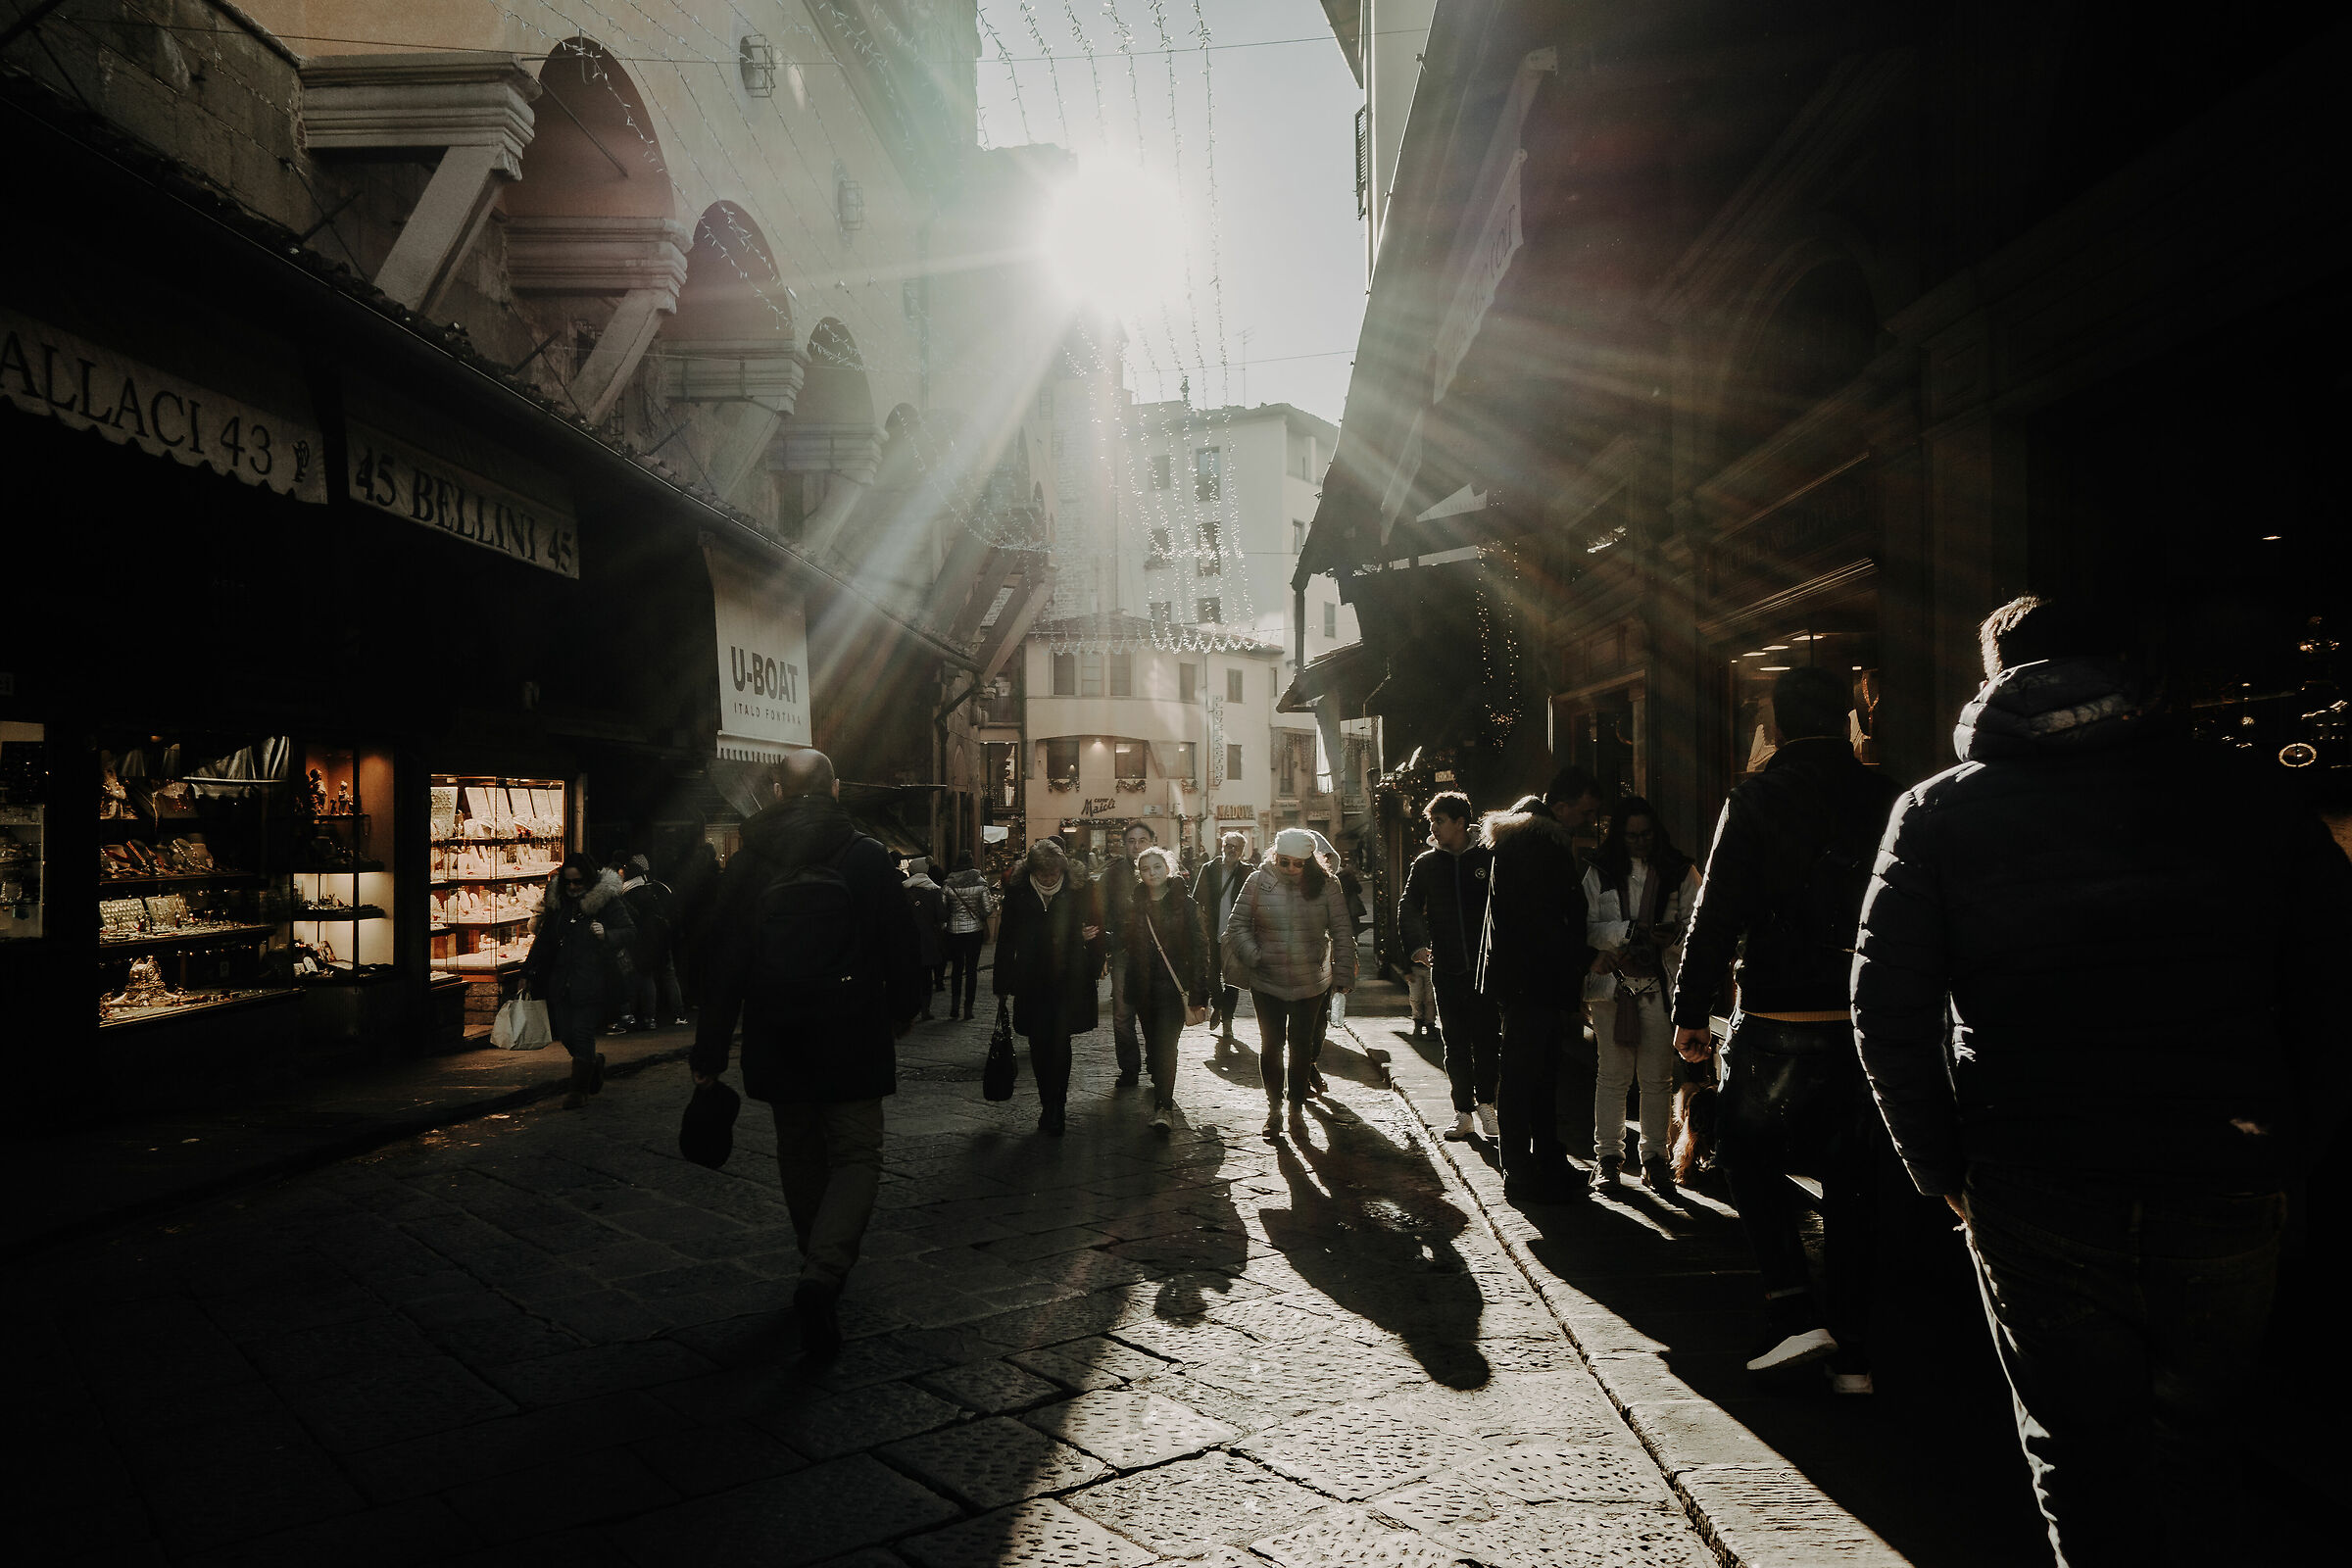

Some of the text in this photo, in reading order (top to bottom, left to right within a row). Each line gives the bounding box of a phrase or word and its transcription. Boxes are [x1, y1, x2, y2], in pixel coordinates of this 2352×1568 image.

[0, 331, 272, 475] ALLACI 43
[357, 447, 573, 572] 45 BELLINI 45
[731, 646, 798, 704] U-BOAT
[734, 703, 760, 717] ITALO
